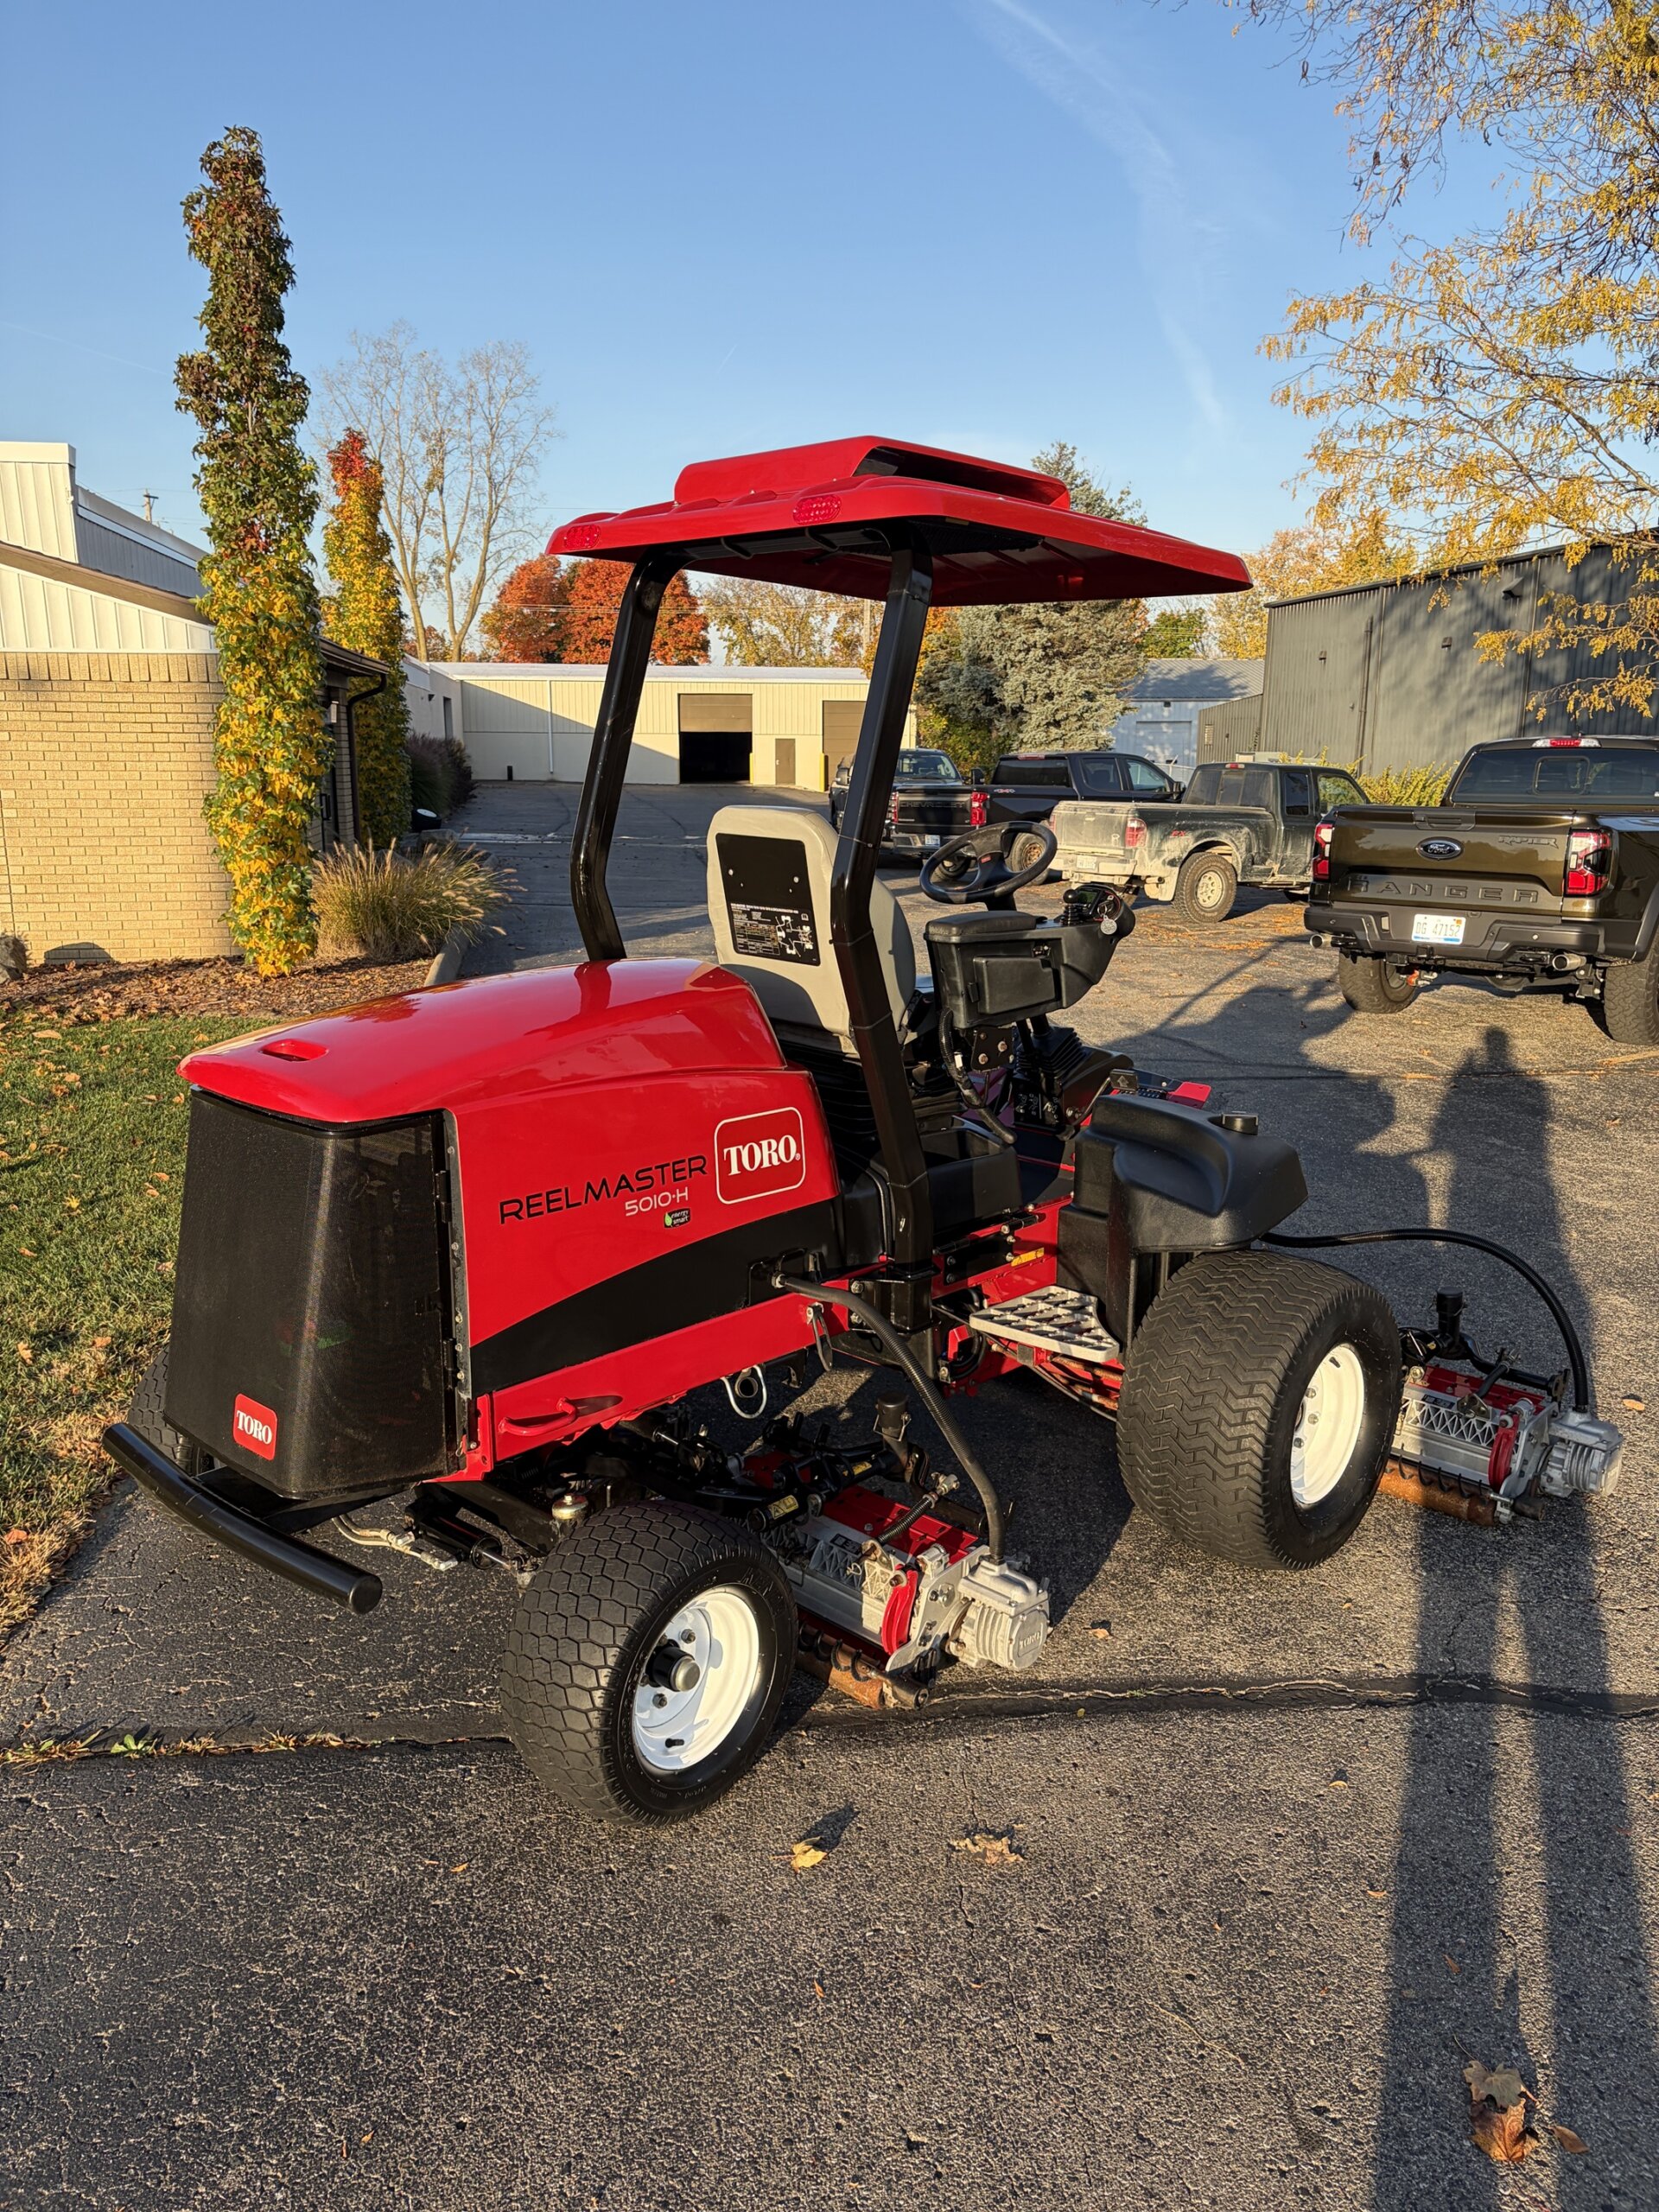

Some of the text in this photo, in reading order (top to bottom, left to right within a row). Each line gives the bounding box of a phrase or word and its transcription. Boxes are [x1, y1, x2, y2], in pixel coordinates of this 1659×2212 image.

[1348, 876, 1538, 903] RANGER
[723, 1135, 797, 1176] TORO
[499, 1154, 708, 1225] REELMASTER
[236, 1410, 273, 1445] TORO
